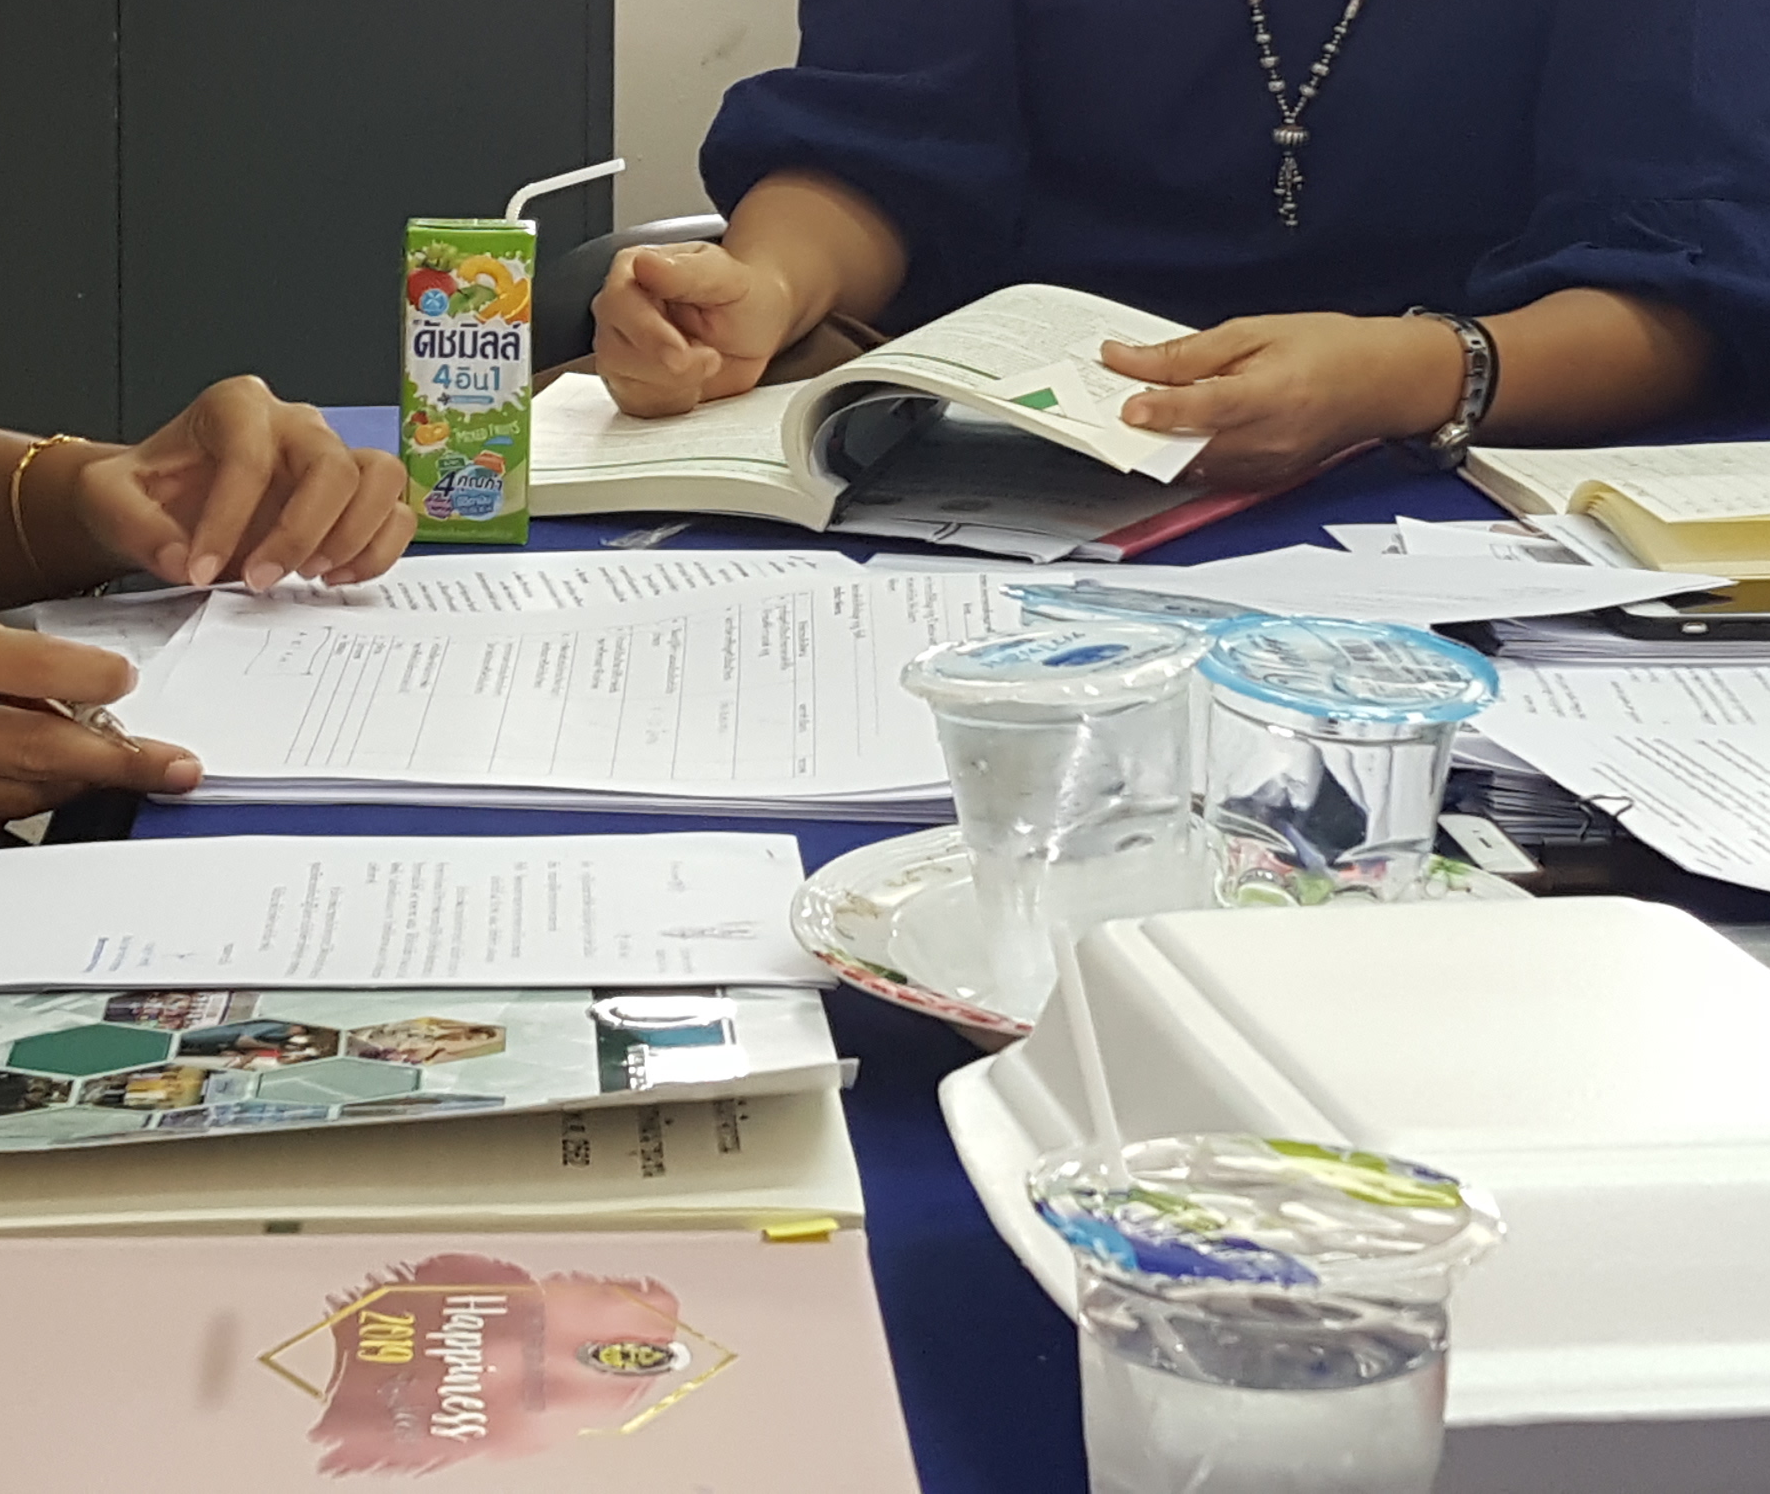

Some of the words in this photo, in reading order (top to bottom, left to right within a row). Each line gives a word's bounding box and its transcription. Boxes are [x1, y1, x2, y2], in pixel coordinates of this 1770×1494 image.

[413, 320, 522, 361] ดัชมิลล์
[356, 1309, 416, 1364] 2019
[425, 1294, 509, 1443] Happiness
